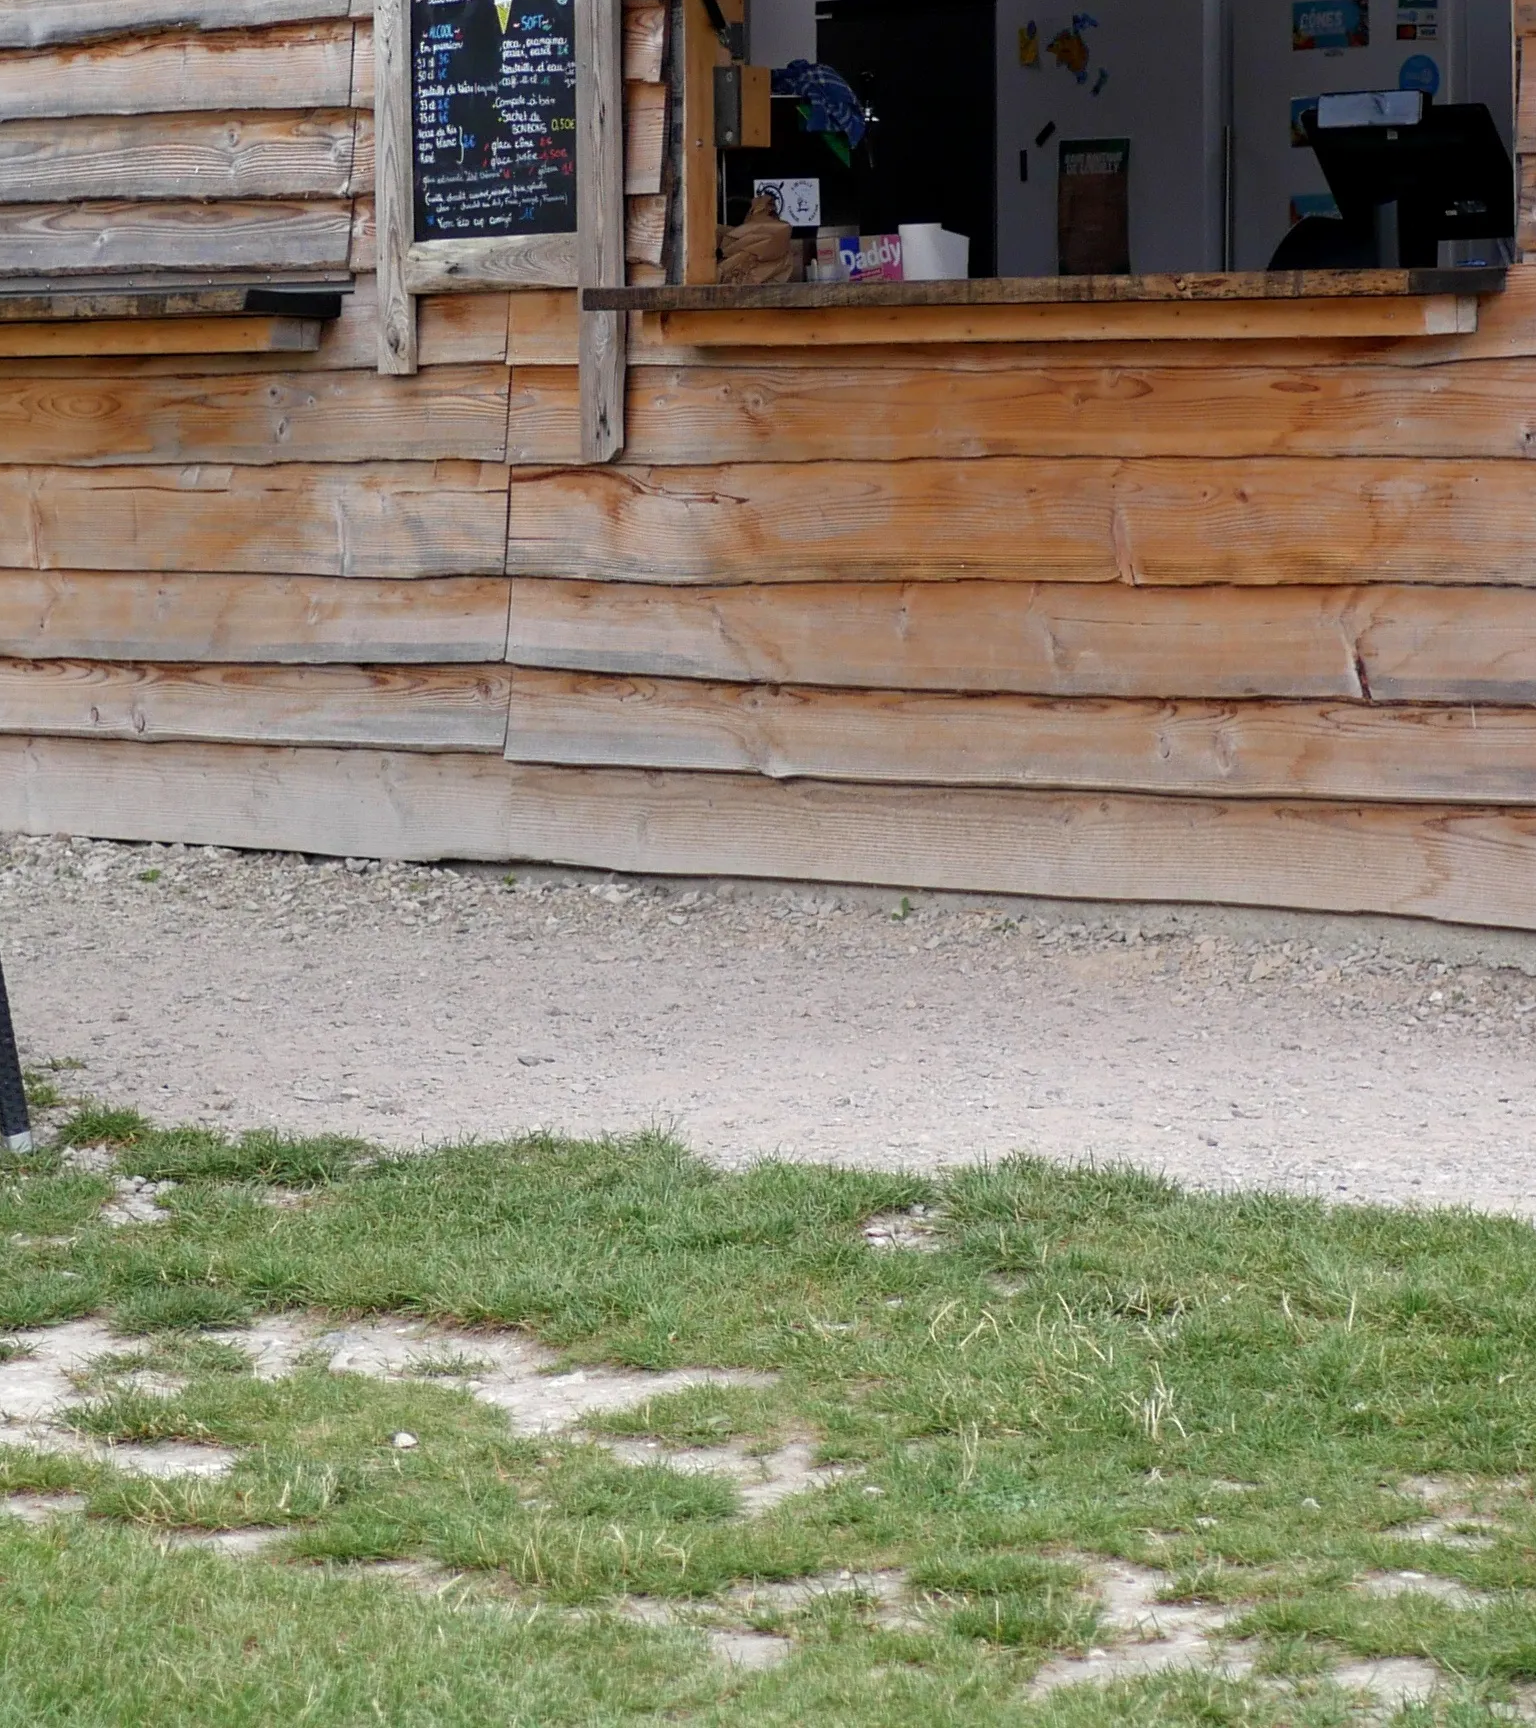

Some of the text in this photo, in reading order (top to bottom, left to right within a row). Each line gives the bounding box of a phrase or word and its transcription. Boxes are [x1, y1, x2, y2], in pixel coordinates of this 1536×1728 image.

[520, 15, 544, 31] SOFT
[511, 122, 547, 135] BONBONS
[839, 237, 901, 273] Daddy
